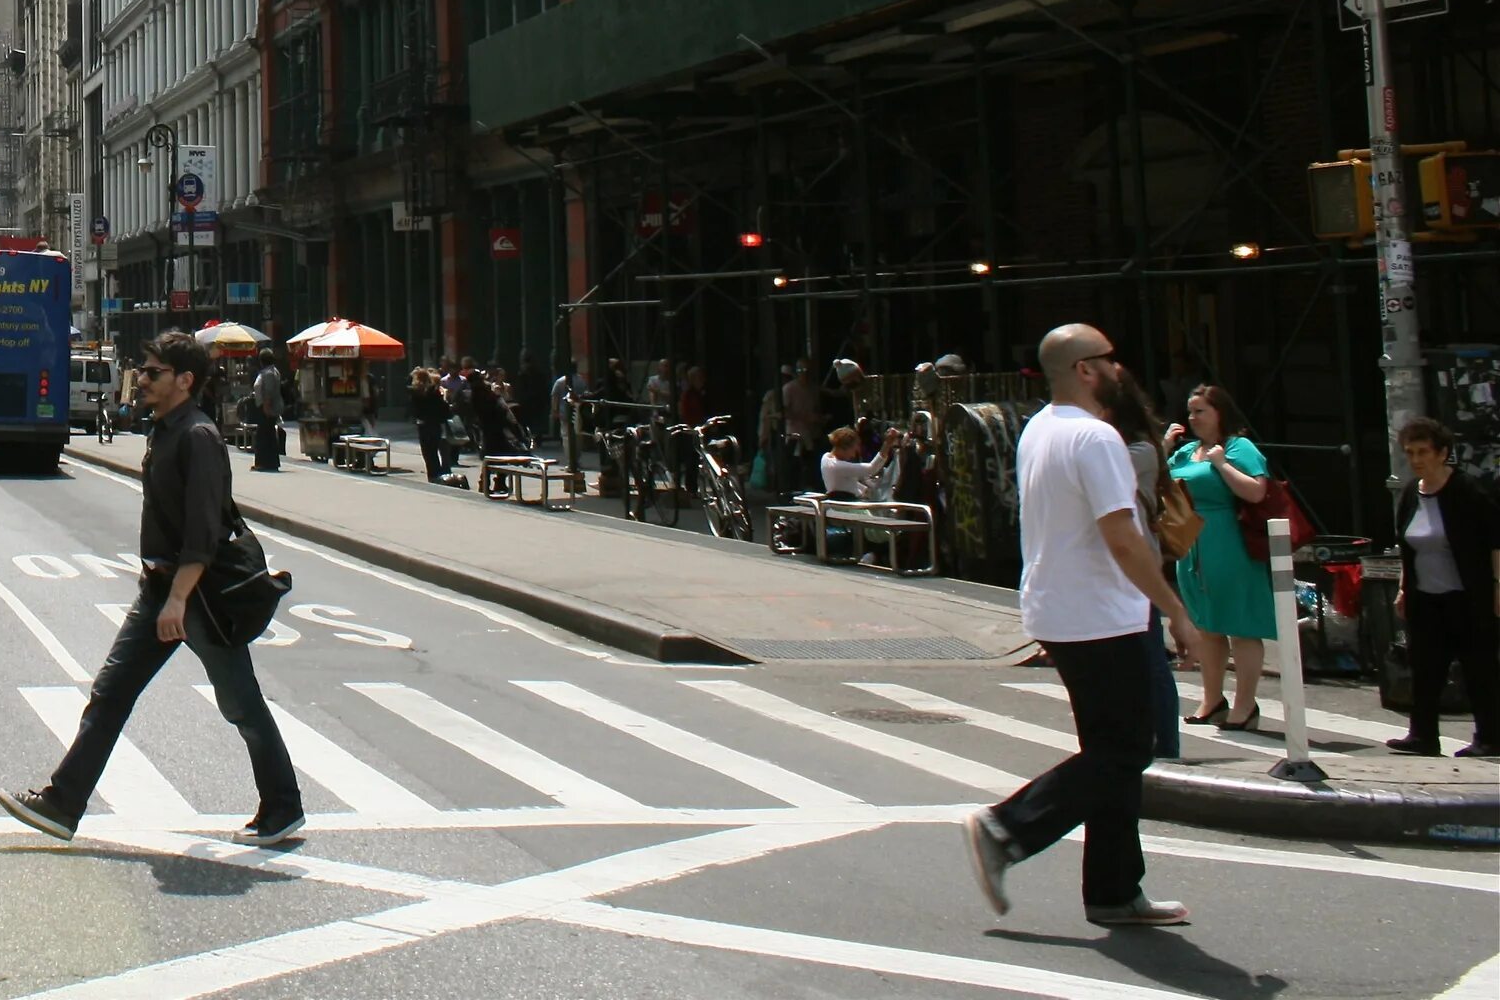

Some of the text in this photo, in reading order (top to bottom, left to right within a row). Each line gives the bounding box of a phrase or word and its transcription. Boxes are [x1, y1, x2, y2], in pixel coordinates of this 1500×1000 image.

[73, 200, 82, 248] CRYSTALLIZED
[29, 279, 50, 293] NY
[18, 337, 30, 346] off
